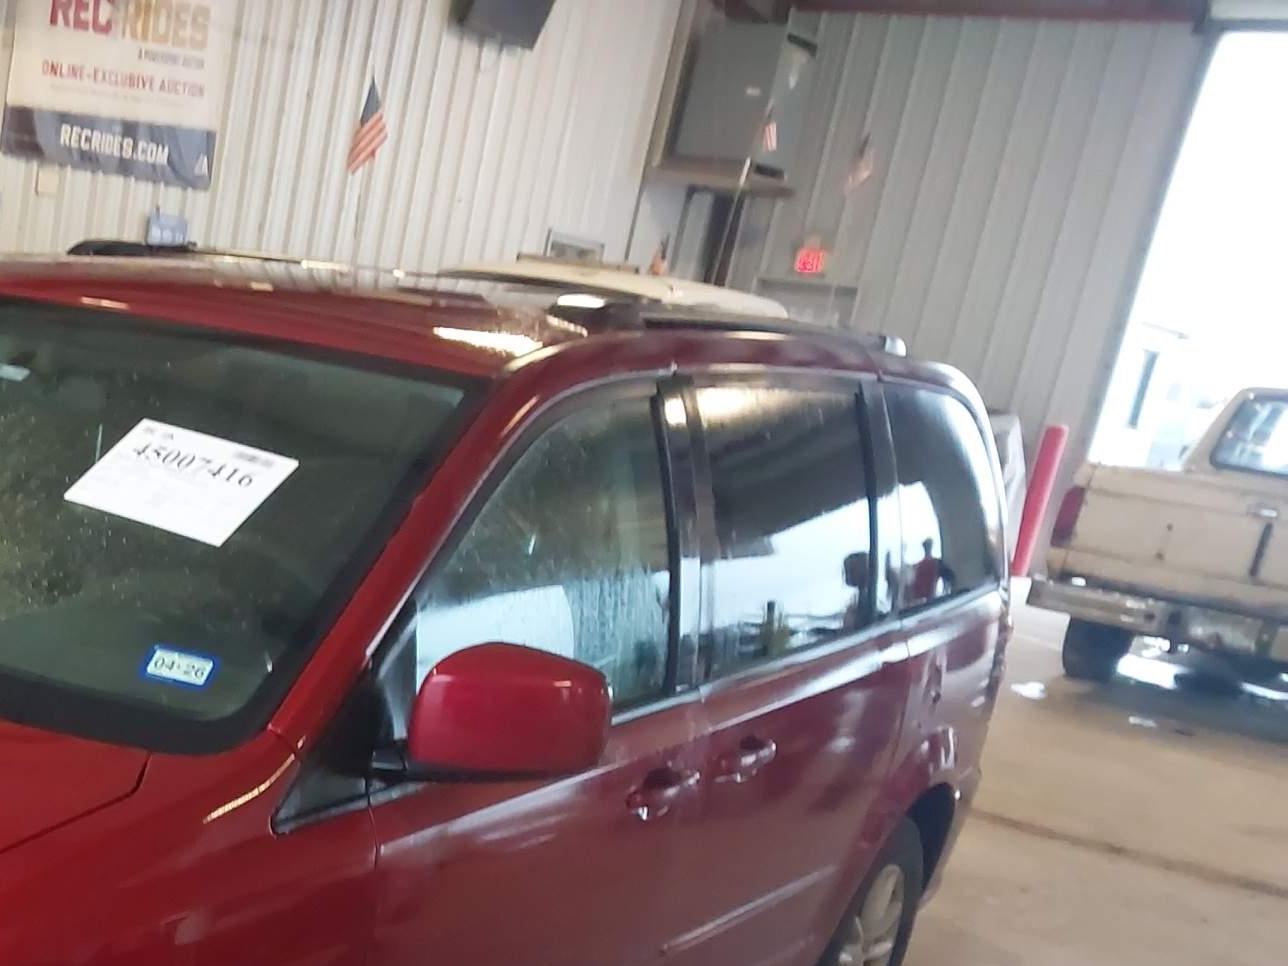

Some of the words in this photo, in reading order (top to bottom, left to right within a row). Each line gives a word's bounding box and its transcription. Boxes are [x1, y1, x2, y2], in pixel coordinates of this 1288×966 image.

[41, 60, 155, 91] ONLINE-EXCLUSIVE
[159, 75, 206, 98] AUCTION
[59, 123, 169, 165] RECRIDES.COM
